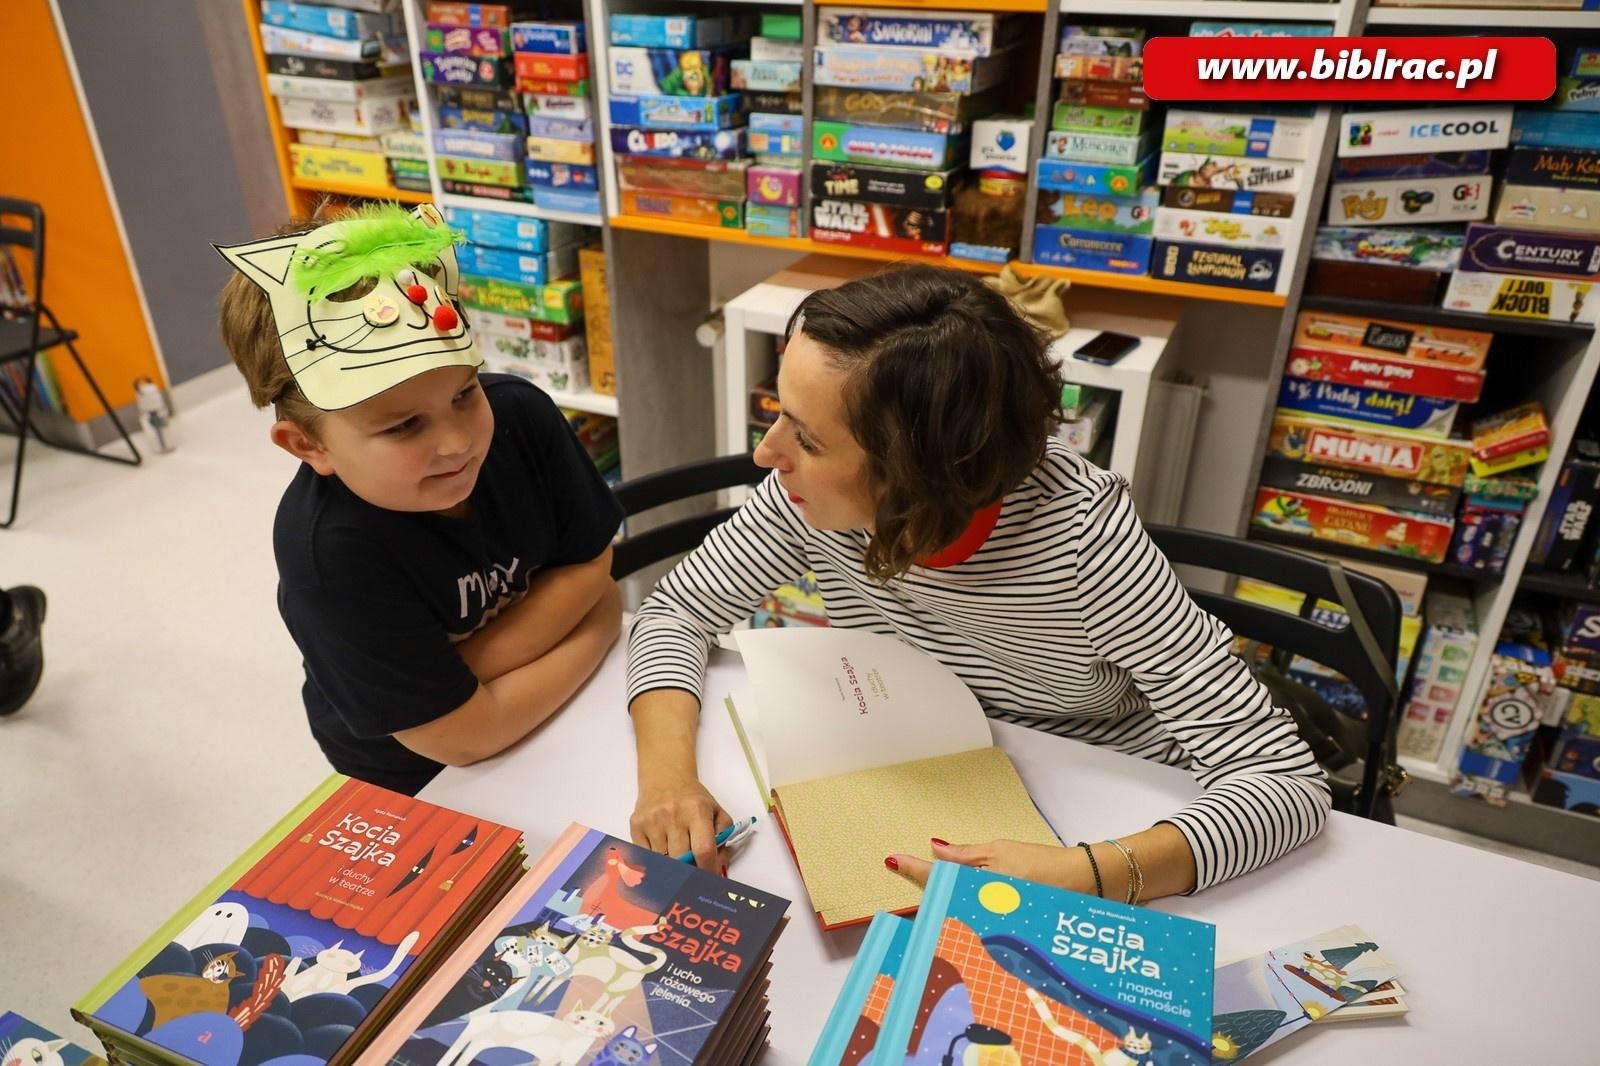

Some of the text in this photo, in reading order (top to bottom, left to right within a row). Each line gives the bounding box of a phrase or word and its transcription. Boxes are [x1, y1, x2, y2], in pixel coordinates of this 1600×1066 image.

[1410, 121, 1498, 138] ICECOOL
[824, 178, 859, 195] TIME
[814, 200, 866, 217] STAR
[815, 212, 869, 232] WARS
[1496, 240, 1583, 260] CENTURY
[1493, 294, 1550, 315] BLOCK
[1312, 434, 1414, 470] MUMIA
[1296, 473, 1373, 496] ZBRODNI
[854, 687, 868, 715] Kocia
[336, 813, 401, 846] Kocia
[318, 829, 397, 867] Szajka
[337, 865, 375, 884] i duchy
[329, 876, 376, 897] w teatrze
[1088, 907, 1105, 916] Agata
[665, 902, 742, 945] Kocia
[1056, 912, 1145, 951] Kocia
[649, 923, 742, 973] Szajka
[1051, 934, 1161, 979] Szajka
[666, 963, 702, 984] i ucho
[650, 985, 690, 1008] jelenia
[660, 974, 716, 1004] różowego
[1118, 978, 1173, 1000] i napad
[1118, 991, 1192, 1018] na moście
